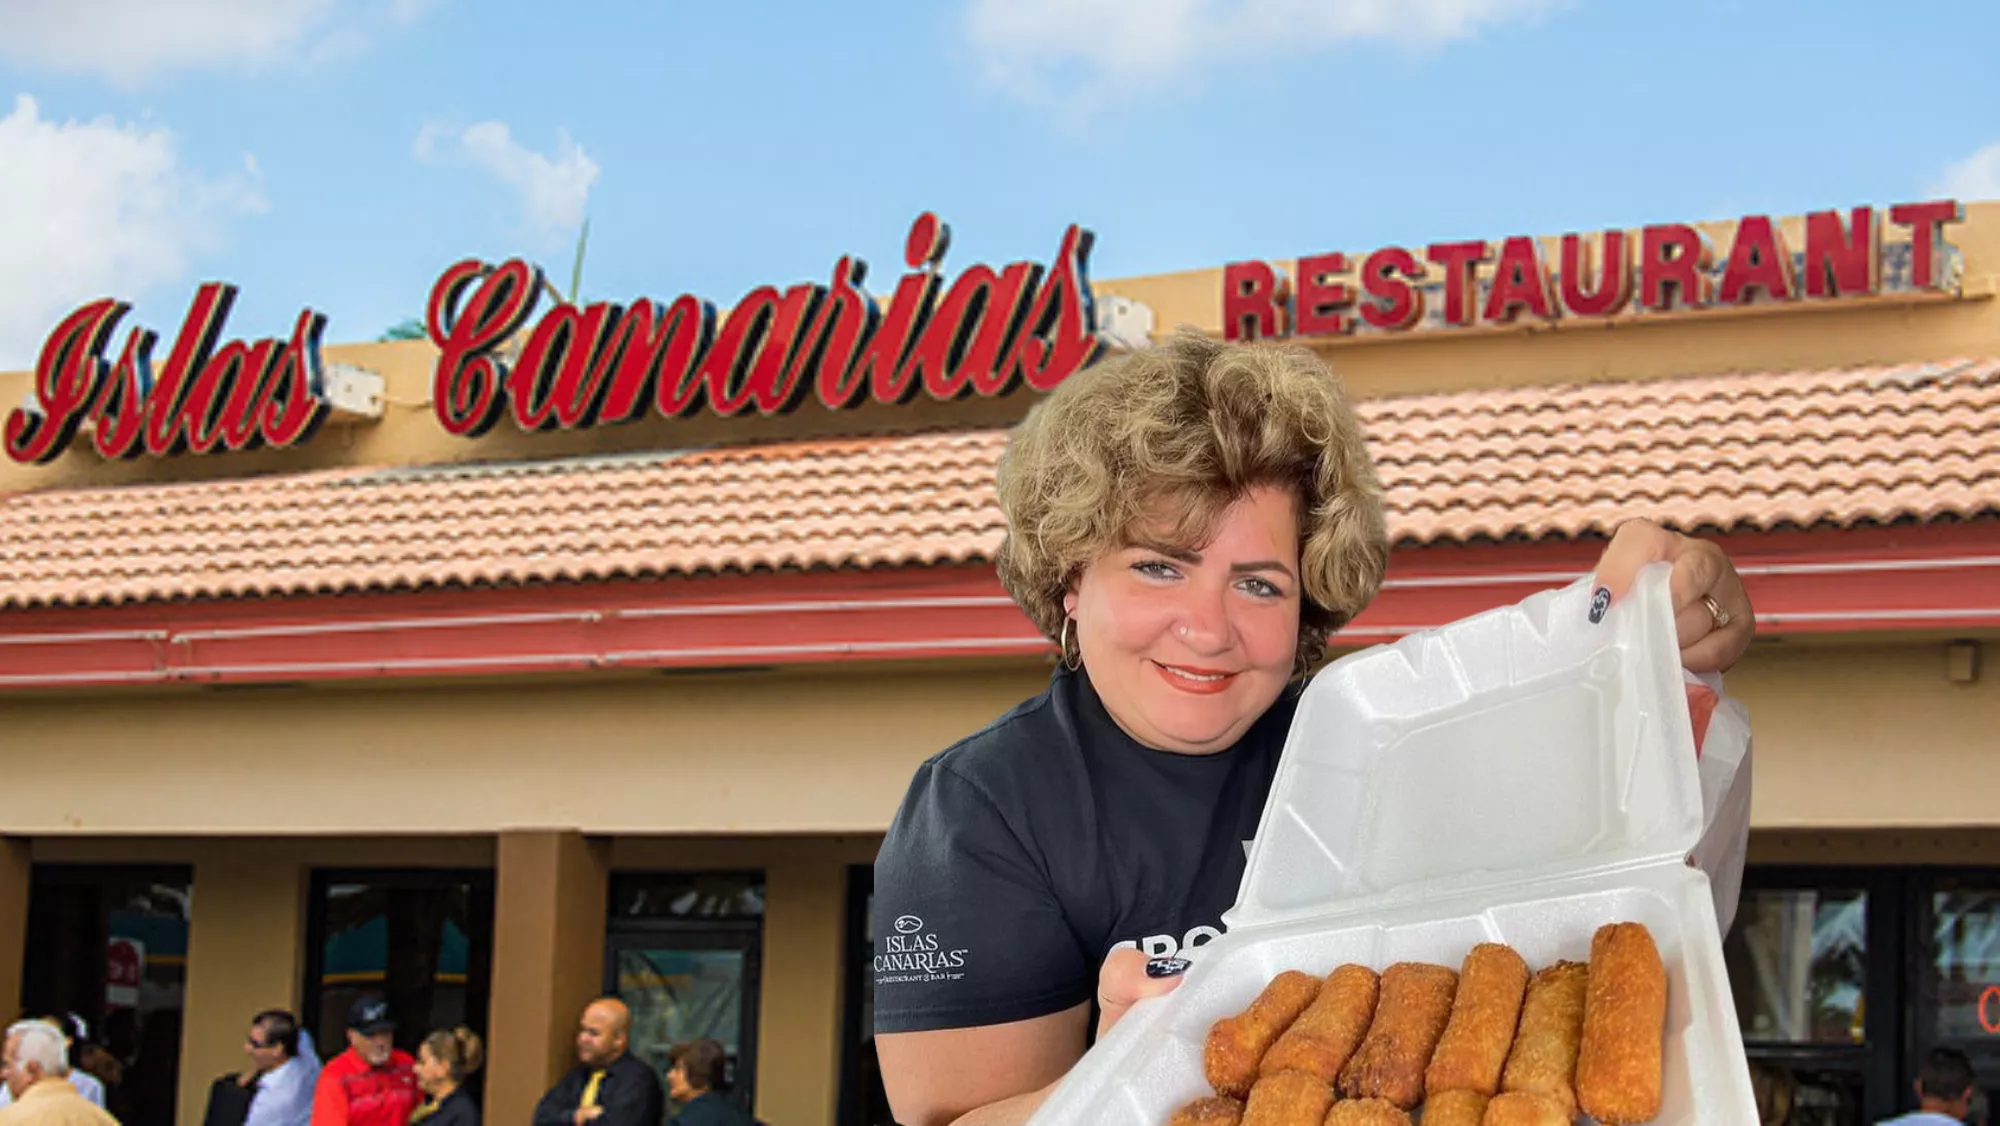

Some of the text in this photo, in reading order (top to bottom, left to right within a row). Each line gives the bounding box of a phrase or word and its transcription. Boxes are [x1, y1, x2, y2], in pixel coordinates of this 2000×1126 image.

[1223, 199, 1957, 341] RESTAURANT
[3, 210, 1104, 464] Islas Canarias
[873, 949, 965, 973] CANARIAS
[885, 933, 938, 953] ISLAS
